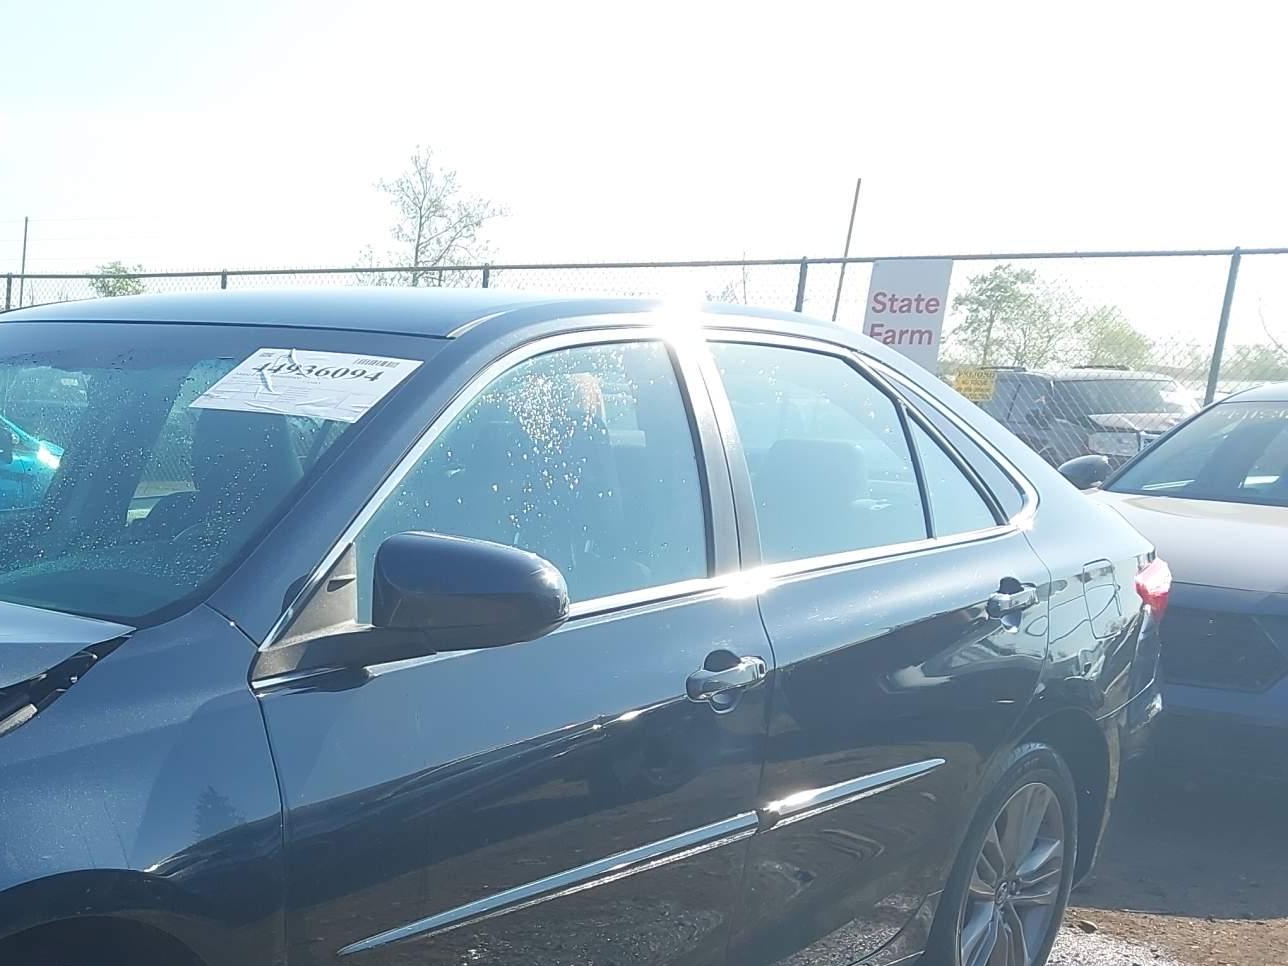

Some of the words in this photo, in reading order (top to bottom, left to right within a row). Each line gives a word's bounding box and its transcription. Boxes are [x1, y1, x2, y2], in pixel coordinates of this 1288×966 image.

[871, 291, 941, 314] State
[869, 323, 933, 345] Farm
[252, 361, 385, 382] 44936094
